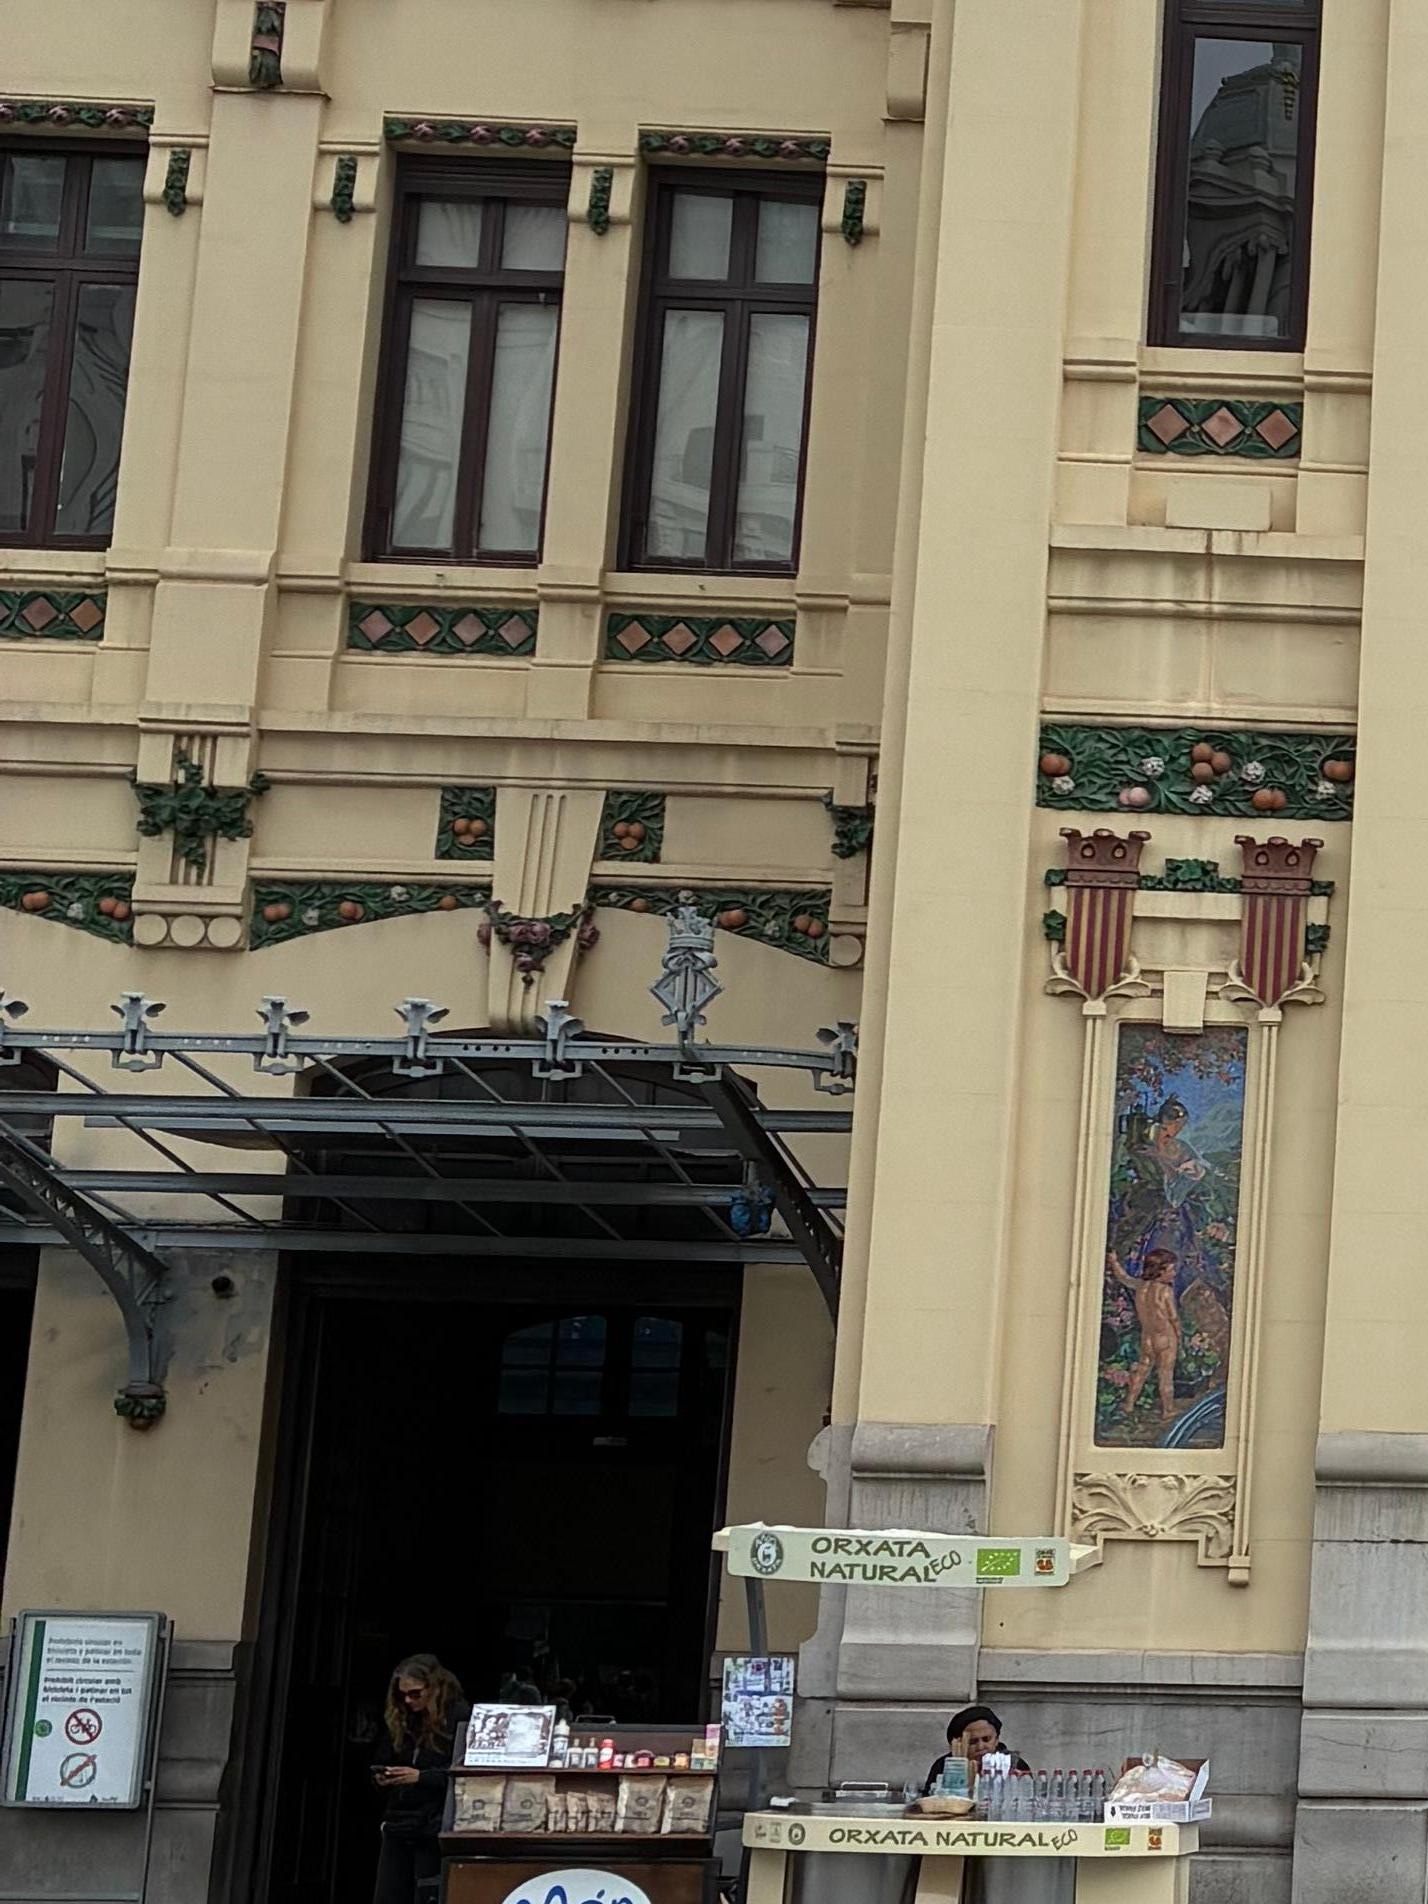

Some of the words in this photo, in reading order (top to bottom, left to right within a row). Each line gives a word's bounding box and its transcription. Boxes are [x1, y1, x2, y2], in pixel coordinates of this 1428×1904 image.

[811, 1536, 932, 1559] ORXATA
[809, 1560, 937, 1584] NATURAL
[930, 1549, 963, 1578] ECO
[828, 1827, 929, 1847] ORXATA
[936, 1830, 1051, 1848] NATURAL
[1050, 1828, 1079, 1851] ECO
